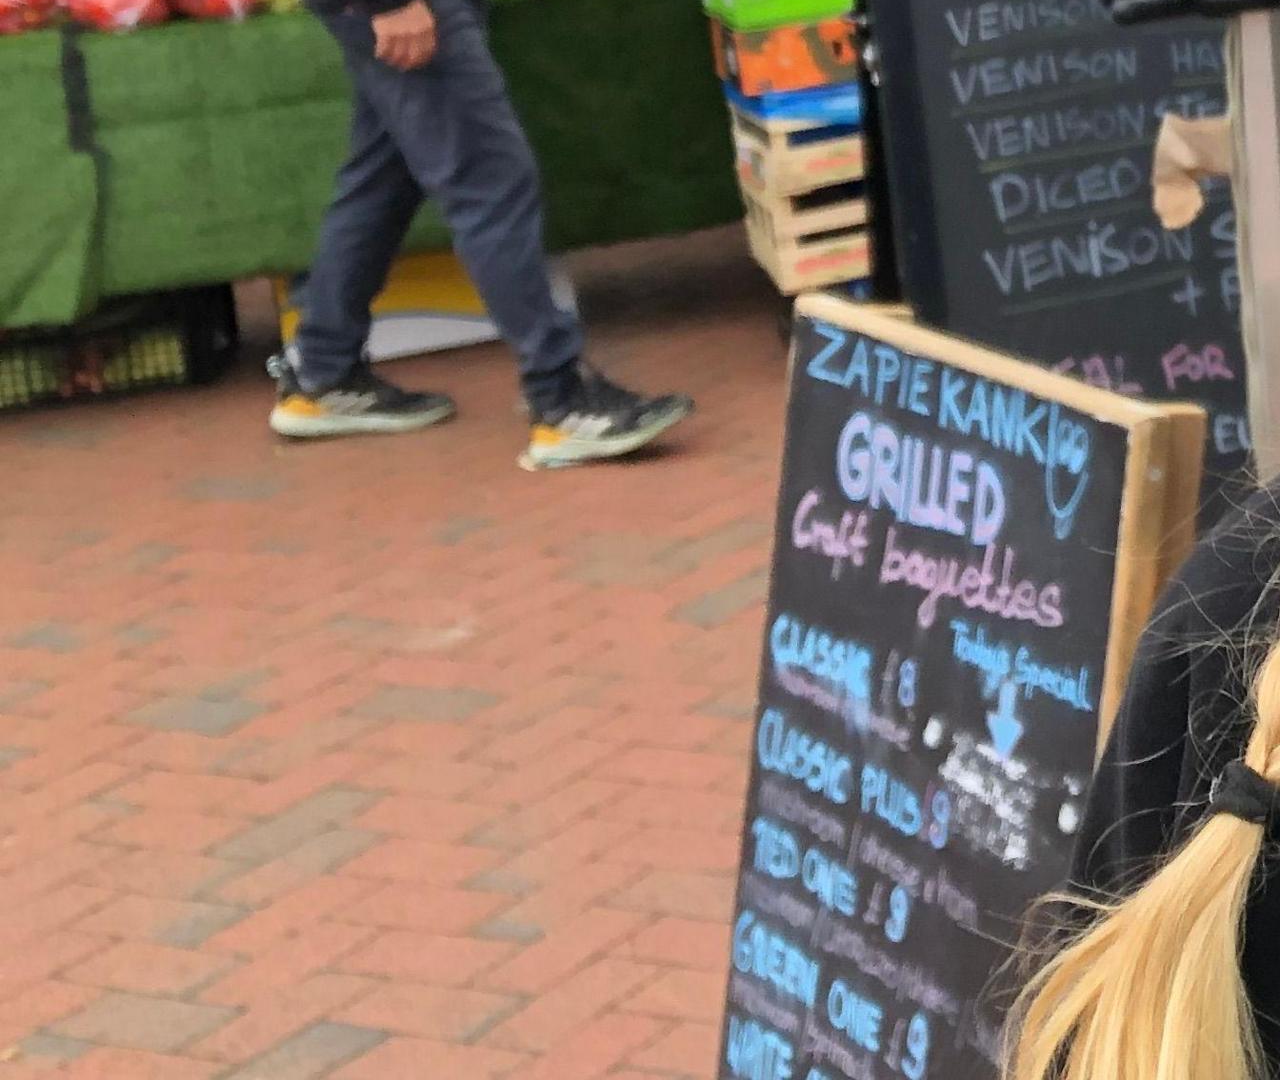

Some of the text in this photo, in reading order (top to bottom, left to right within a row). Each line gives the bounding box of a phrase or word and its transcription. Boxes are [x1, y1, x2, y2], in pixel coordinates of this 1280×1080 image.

[951, 46, 1138, 106] VENISON
[964, 102, 1146, 161] VENISON
[988, 157, 1143, 223] DICED
[836, 410, 1006, 547] GRILLED
